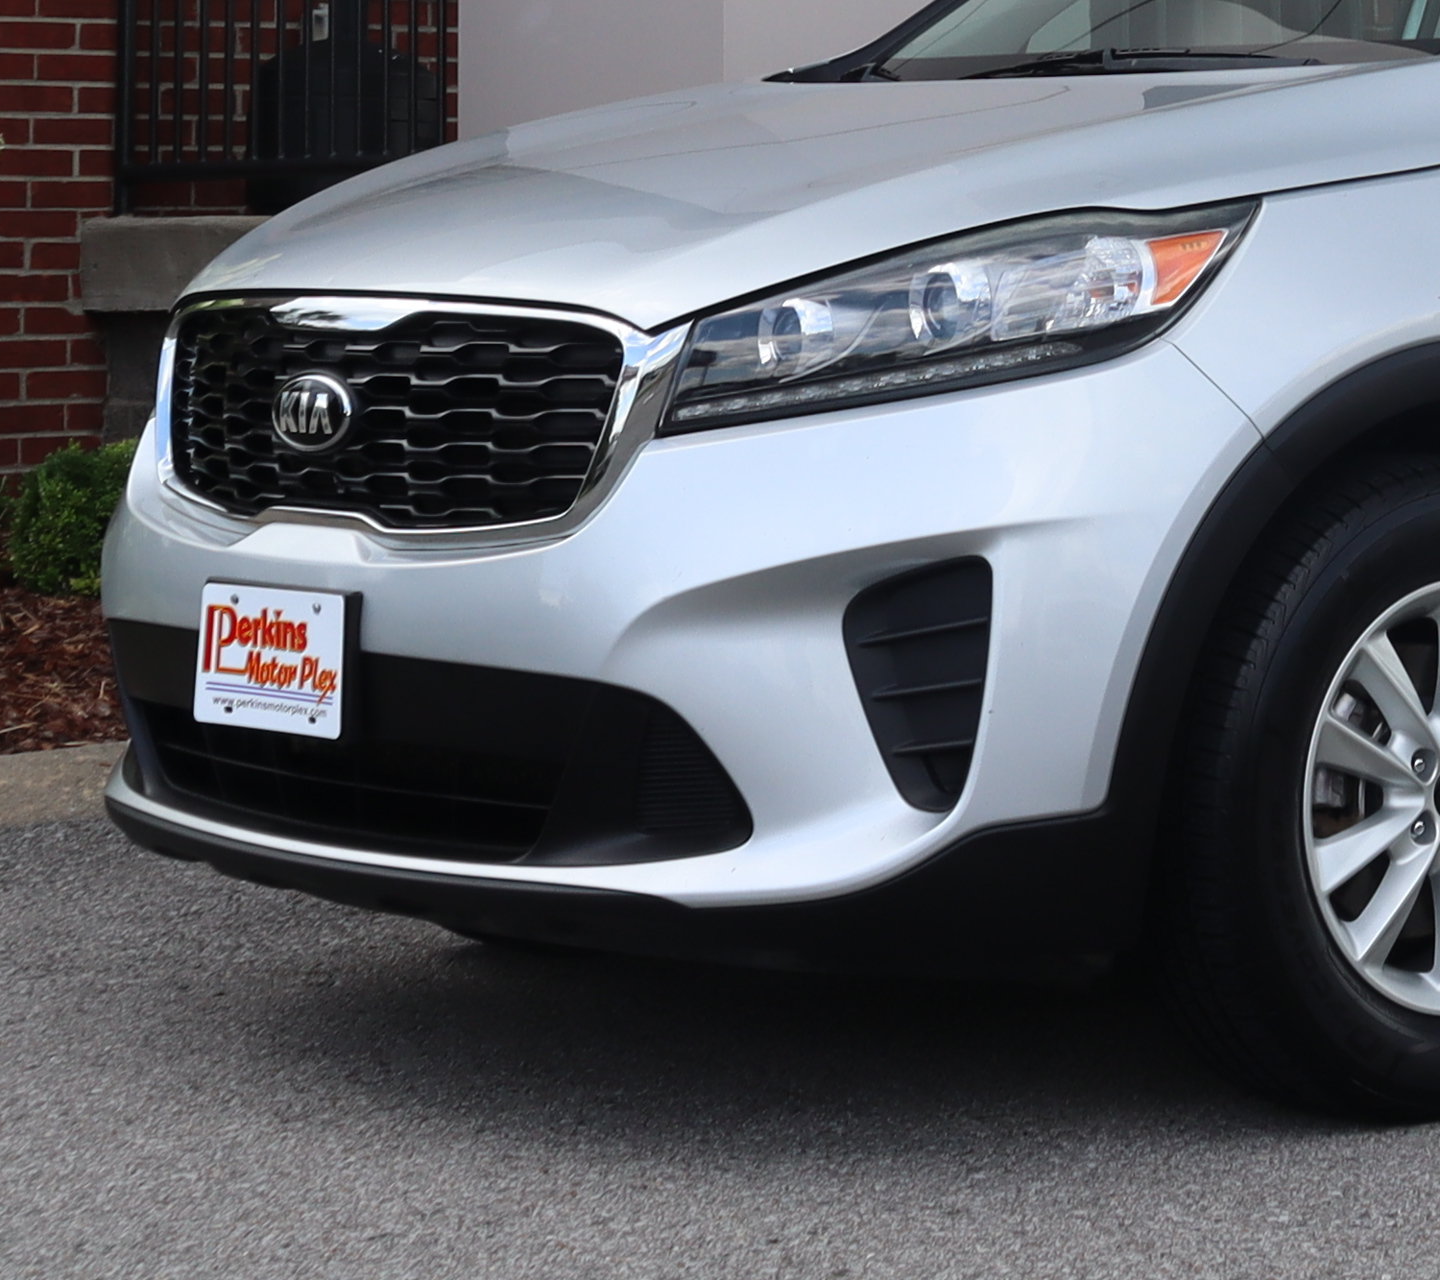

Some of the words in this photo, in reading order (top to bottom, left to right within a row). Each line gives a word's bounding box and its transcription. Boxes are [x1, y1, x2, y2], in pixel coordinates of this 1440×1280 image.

[279, 391, 333, 434] KIA
[202, 604, 308, 674] Perkins
[247, 650, 298, 689] Motor
[298, 655, 338, 706] Plex
[212, 695, 327, 718] www.perkinsmotorplex.com
